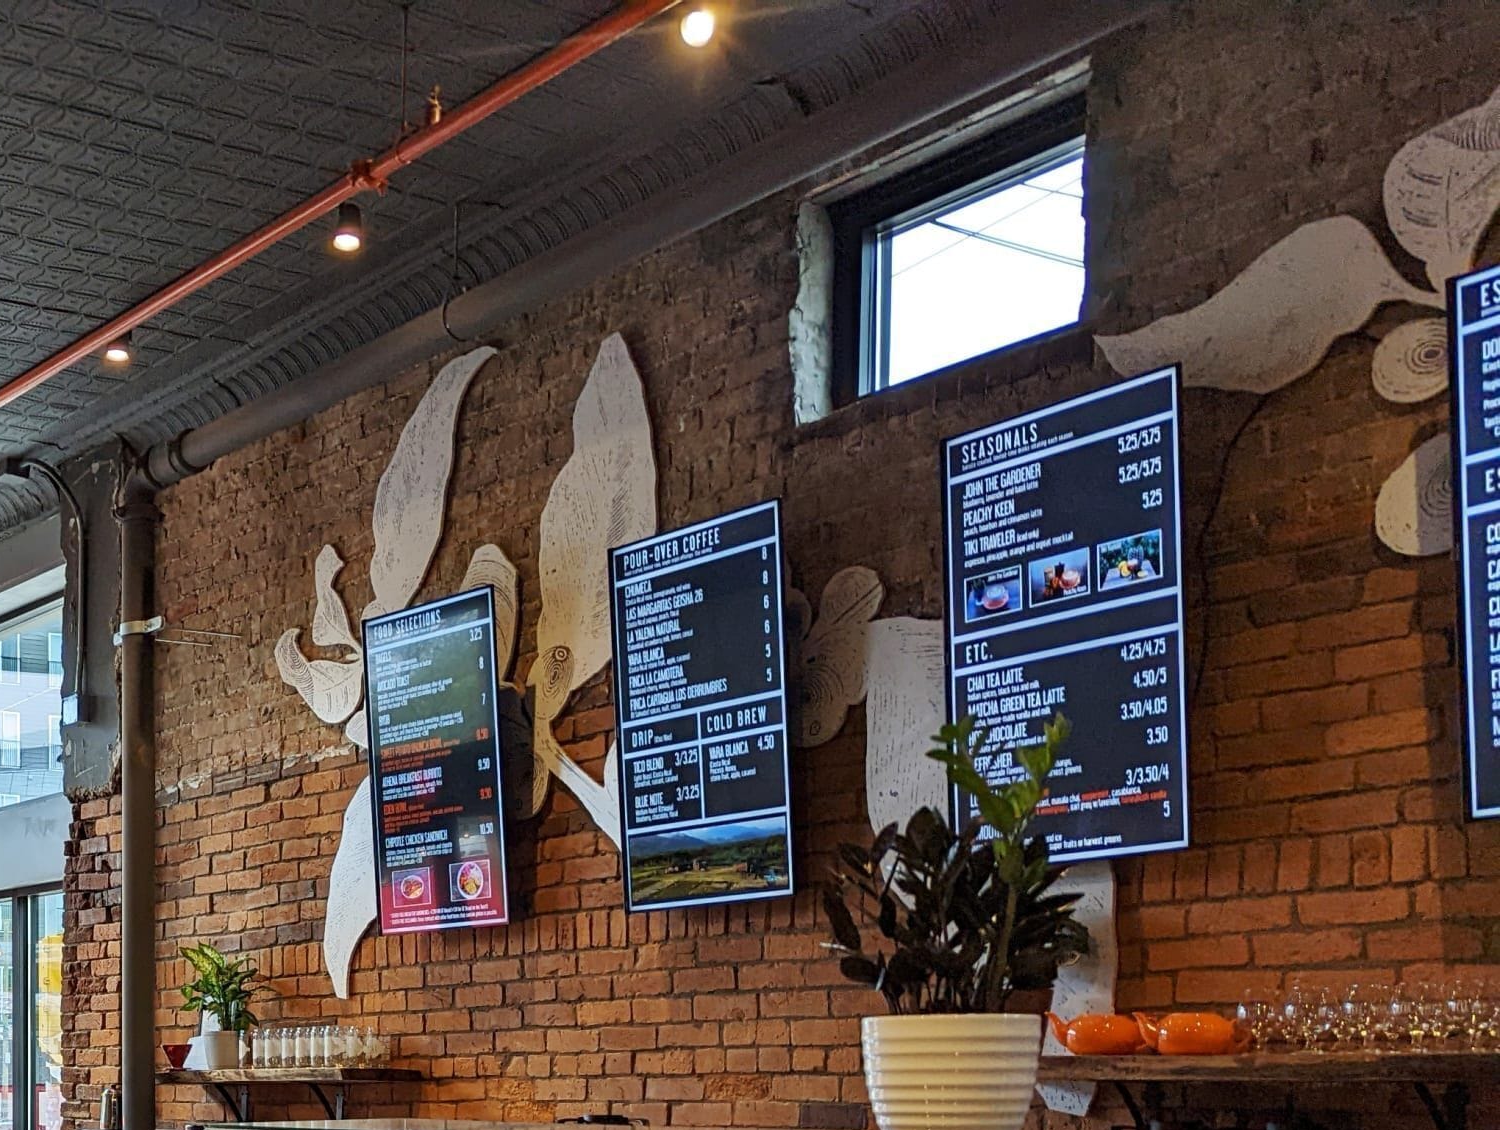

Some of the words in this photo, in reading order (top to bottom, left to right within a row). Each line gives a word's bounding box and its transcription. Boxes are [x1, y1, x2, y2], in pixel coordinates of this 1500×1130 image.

[961, 421, 1037, 464] SEASONALS
[962, 479, 983, 499] JOHN
[984, 474, 999, 492] THE
[1000, 461, 1041, 488] GARDENER
[963, 504, 992, 527] PEACHY
[994, 498, 1014, 518] KEEN
[623, 539, 679, 571] POUR-OVER
[682, 526, 720, 554] COFFEE
[963, 538, 978, 556] TIKI
[979, 528, 1015, 552] TRAVELER
[762, 594, 769, 609] 6
[373, 622, 392, 641] FOOD
[395, 608, 441, 634] SELECTIONS
[625, 606, 636, 621] LAS
[626, 629, 634, 643] LA
[763, 618, 770, 634] 6
[764, 643, 771, 658] 5
[966, 640, 993, 664] ETC.
[1120, 636, 1166, 662] 4.25/4.75
[645, 671, 652, 684] LA
[765, 667, 772, 682] 5
[967, 674, 984, 692] CHAI
[986, 671, 1000, 688] TEA
[1001, 666, 1023, 685] LATTE
[1132, 666, 1167, 689] 4.50/5
[1000, 694, 1025, 713] GREEN
[1026, 690, 1041, 708] TEA
[1042, 686, 1065, 705] LATTE
[706, 712, 732, 733] COLD
[737, 705, 766, 727] BREW
[631, 728, 653, 748] DRIP
[757, 733, 774, 751] 4.50
[1146, 725, 1168, 746] 3.50
[1125, 763, 1169, 786] 3/3.50/4
[1163, 800, 1170, 817] 5
